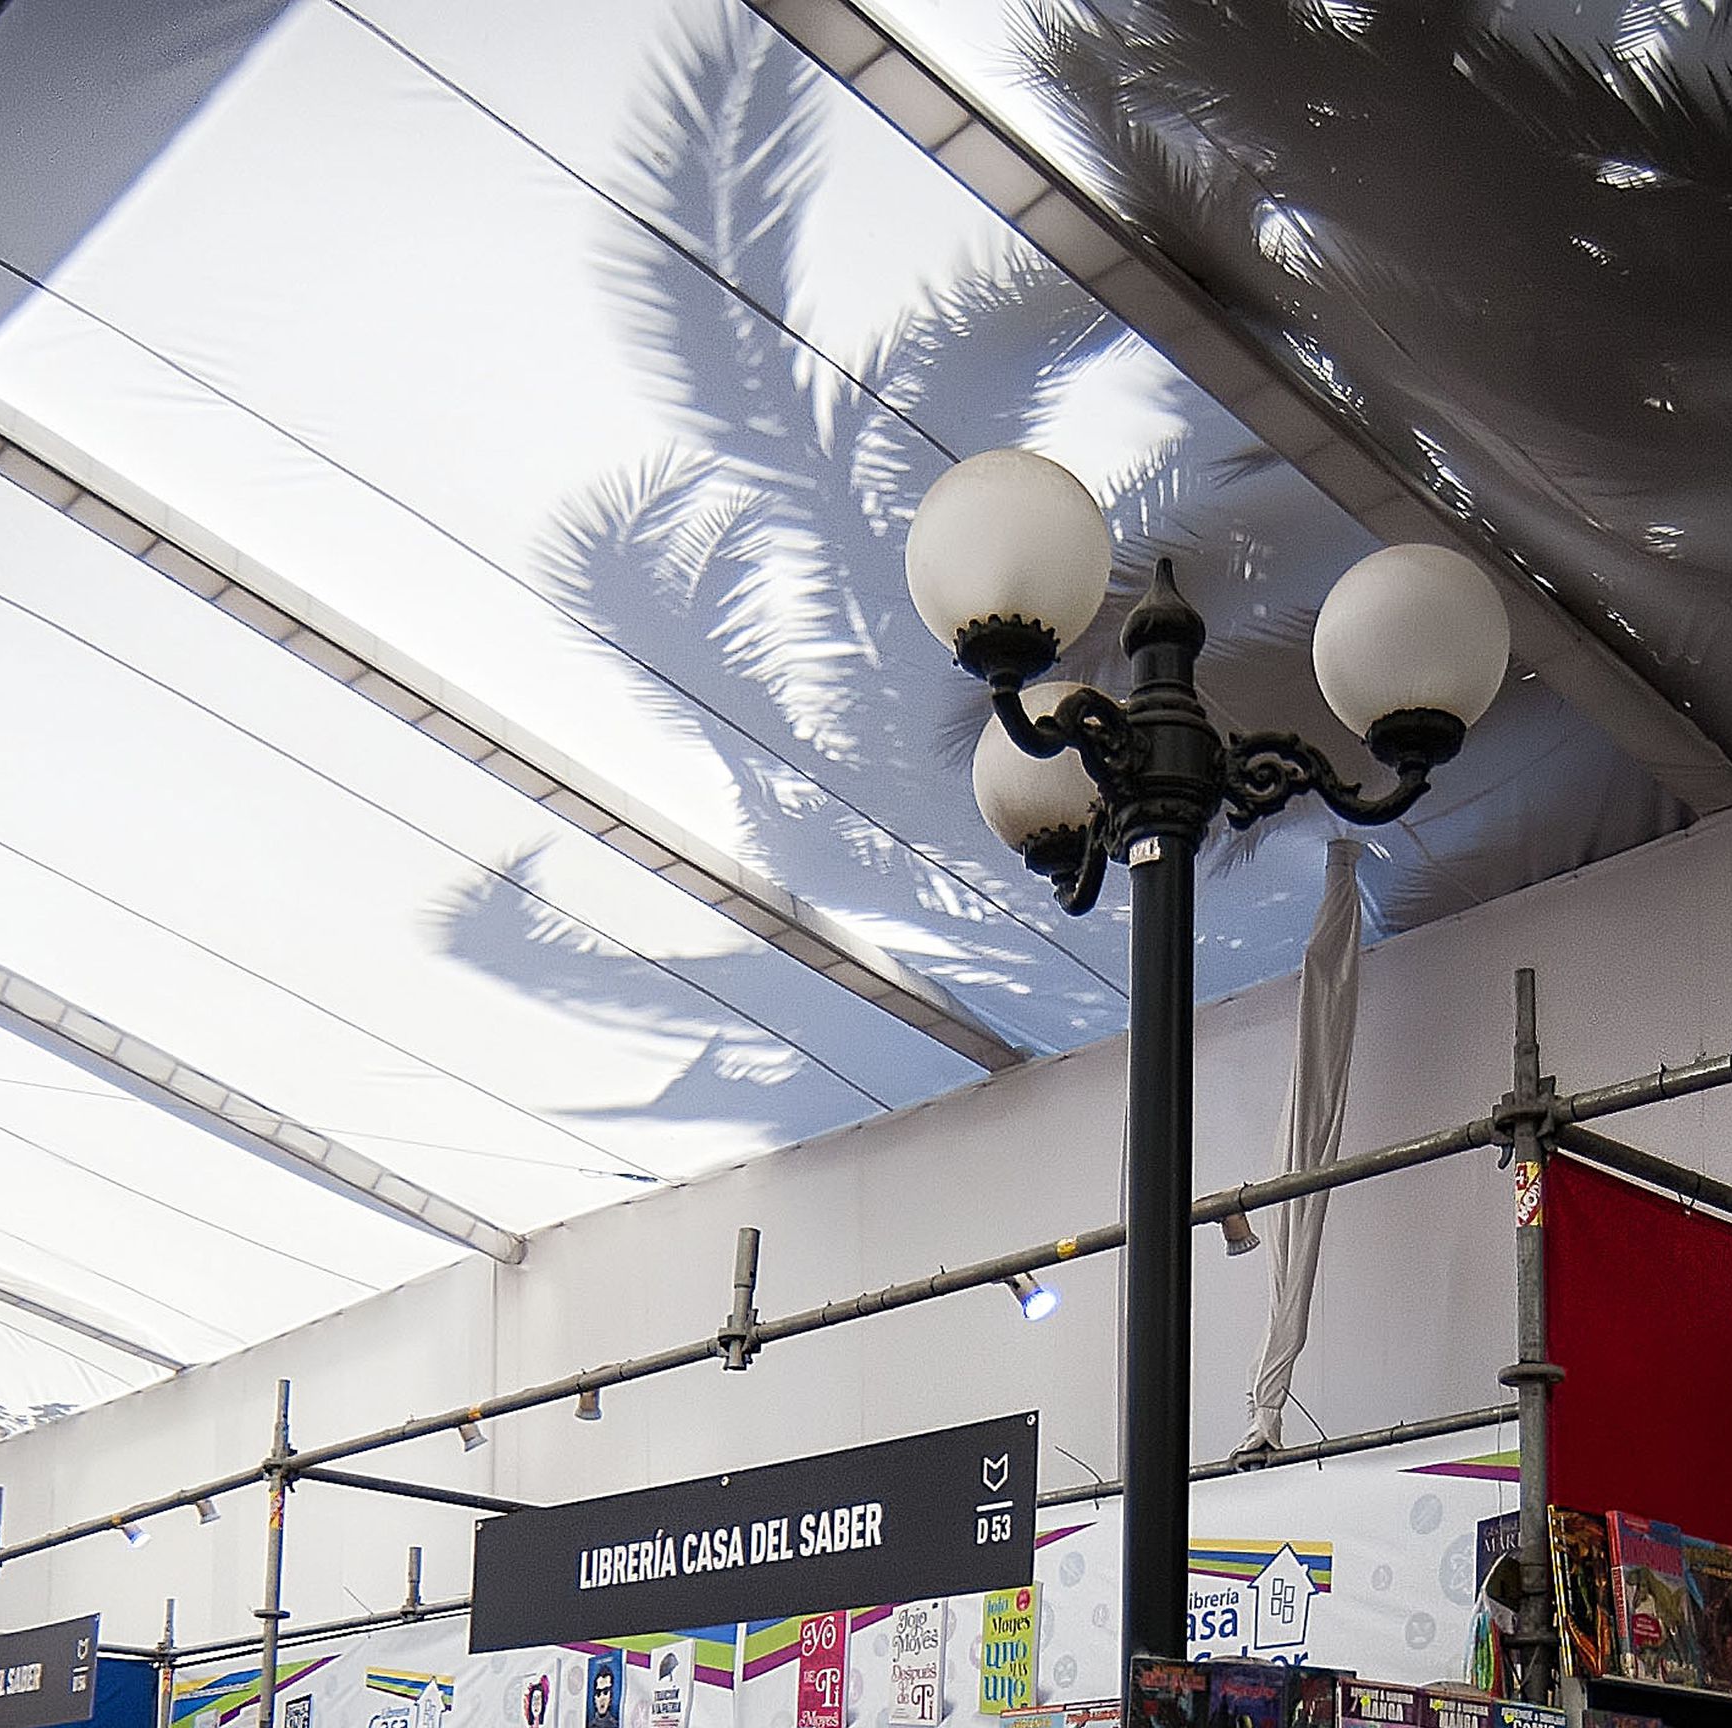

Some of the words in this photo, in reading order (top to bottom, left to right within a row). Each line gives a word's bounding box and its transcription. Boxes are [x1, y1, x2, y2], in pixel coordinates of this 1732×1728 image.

[578, 1529, 677, 1590] LIBRERÍA
[681, 1528, 745, 1576] CASA
[751, 1519, 793, 1565] DEL
[799, 1503, 883, 1560] SABER
[976, 1519, 989, 1546] D
[991, 1513, 1012, 1543] 53
[1189, 1587, 1239, 1611] ibrería
[1186, 1607, 1238, 1642] asa
